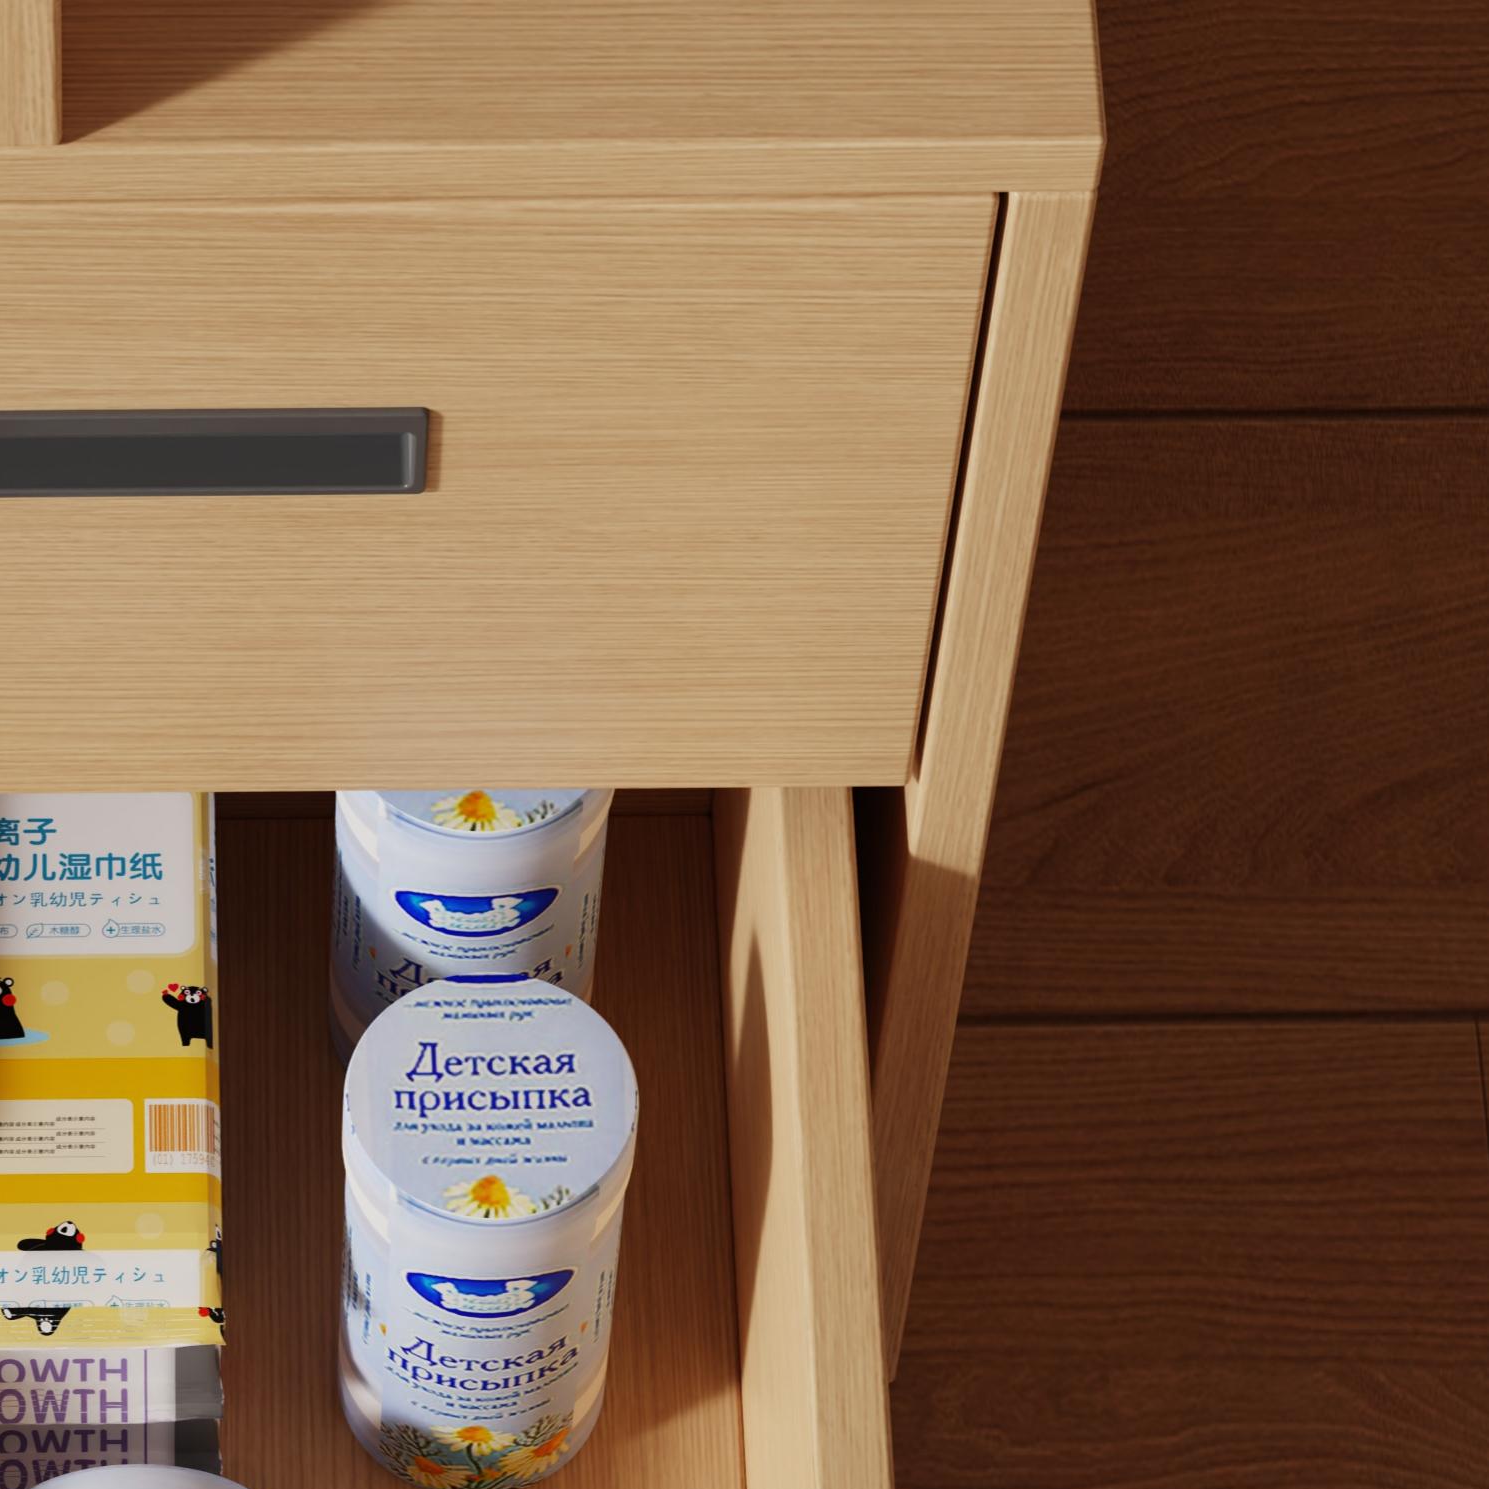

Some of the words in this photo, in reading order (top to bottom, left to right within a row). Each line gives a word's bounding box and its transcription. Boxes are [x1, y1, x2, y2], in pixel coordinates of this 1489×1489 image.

[405, 1042, 576, 1083] Детская
[394, 1086, 592, 1118] присыпка
[388, 1347, 579, 1391] присыпка
[401, 1335, 568, 1372] Детская
